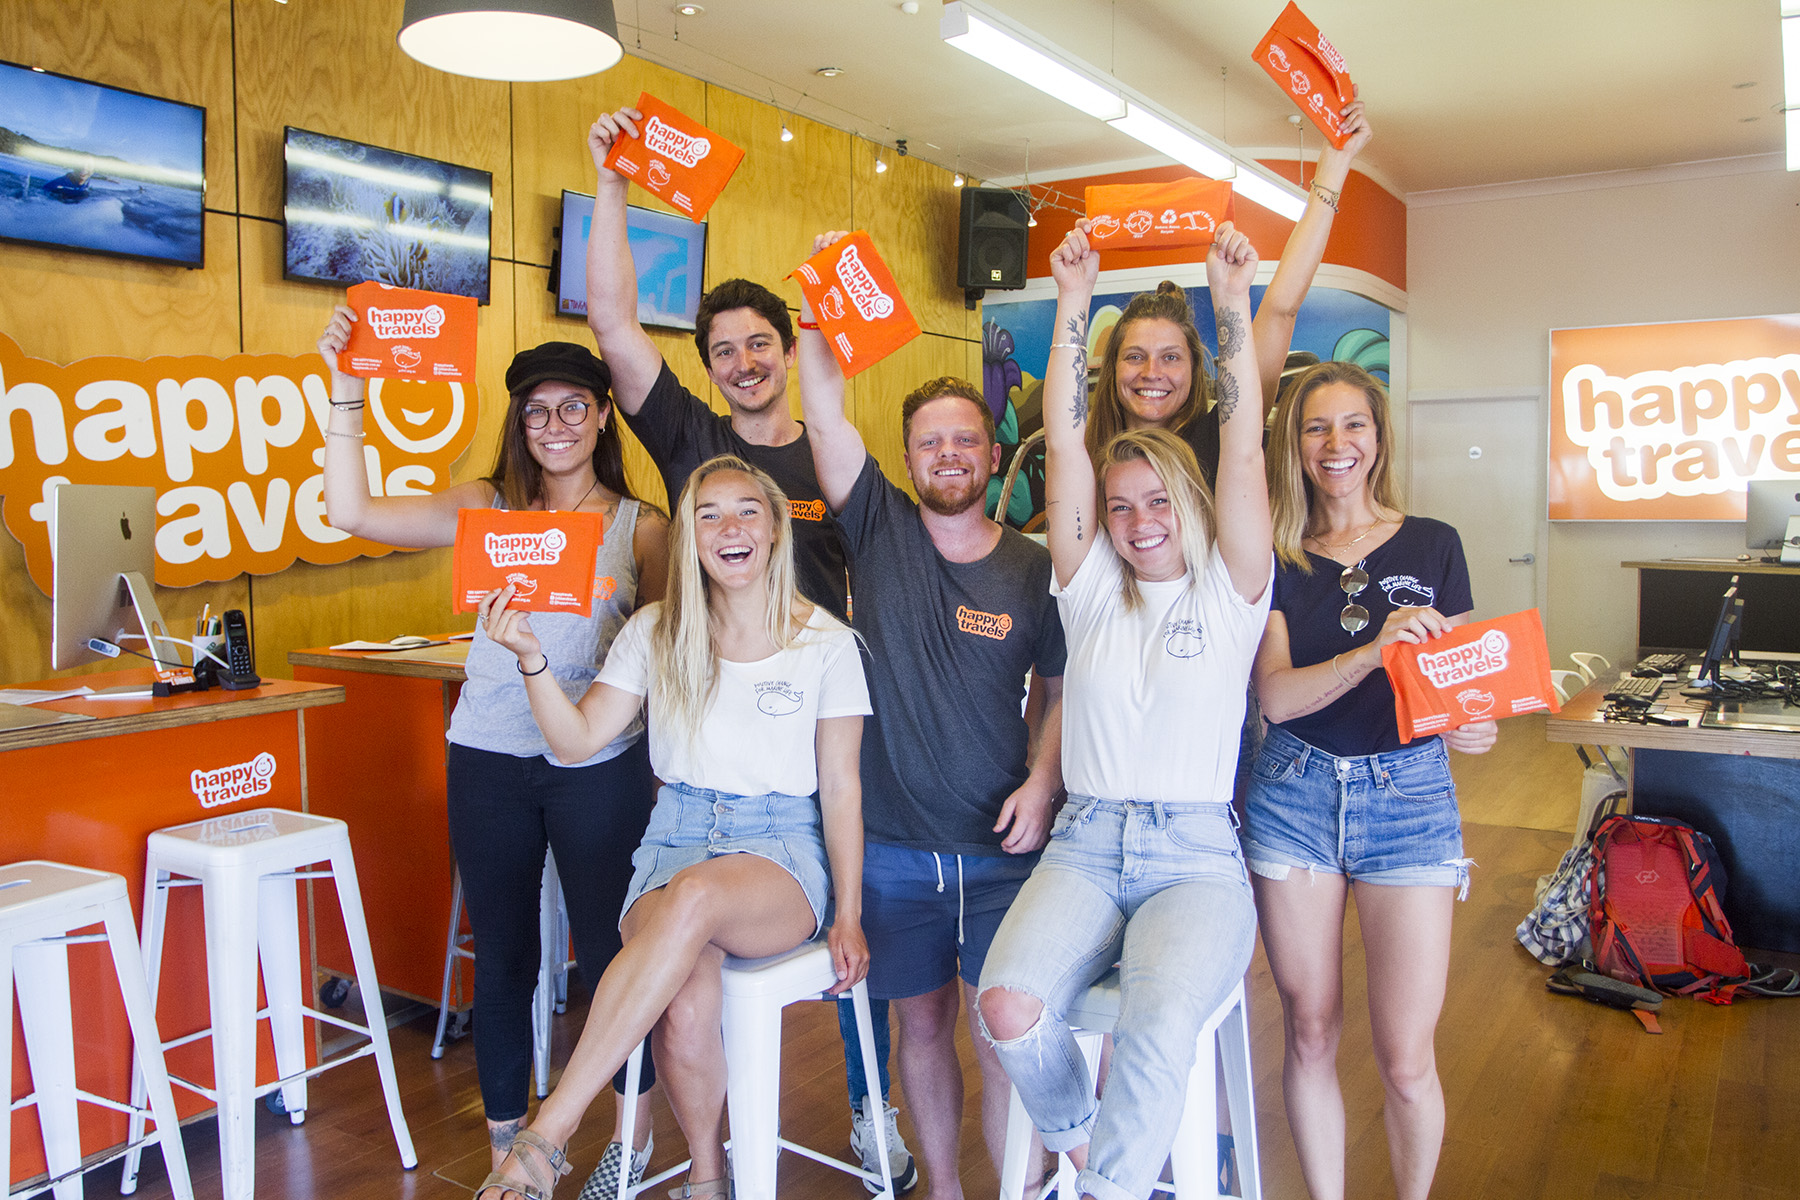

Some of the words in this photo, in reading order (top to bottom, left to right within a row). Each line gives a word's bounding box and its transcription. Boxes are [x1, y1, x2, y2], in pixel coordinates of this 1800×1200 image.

[649, 119, 693, 148] happy
[647, 134, 696, 165] travels
[844, 248, 879, 299] happy
[838, 261, 875, 318] travels
[371, 310, 423, 325] happy
[377, 323, 437, 336] travels
[1602, 430, 1800, 487] trave
[29, 444, 436, 565] avels
[488, 536, 543, 551] happy
[494, 548, 556, 563] travels
[958, 608, 999, 626] happy
[960, 619, 1005, 638] travels
[1421, 643, 1483, 672] happy
[1433, 654, 1503, 685] travels
[195, 765, 253, 790] happy
[202, 777, 267, 804] travels
